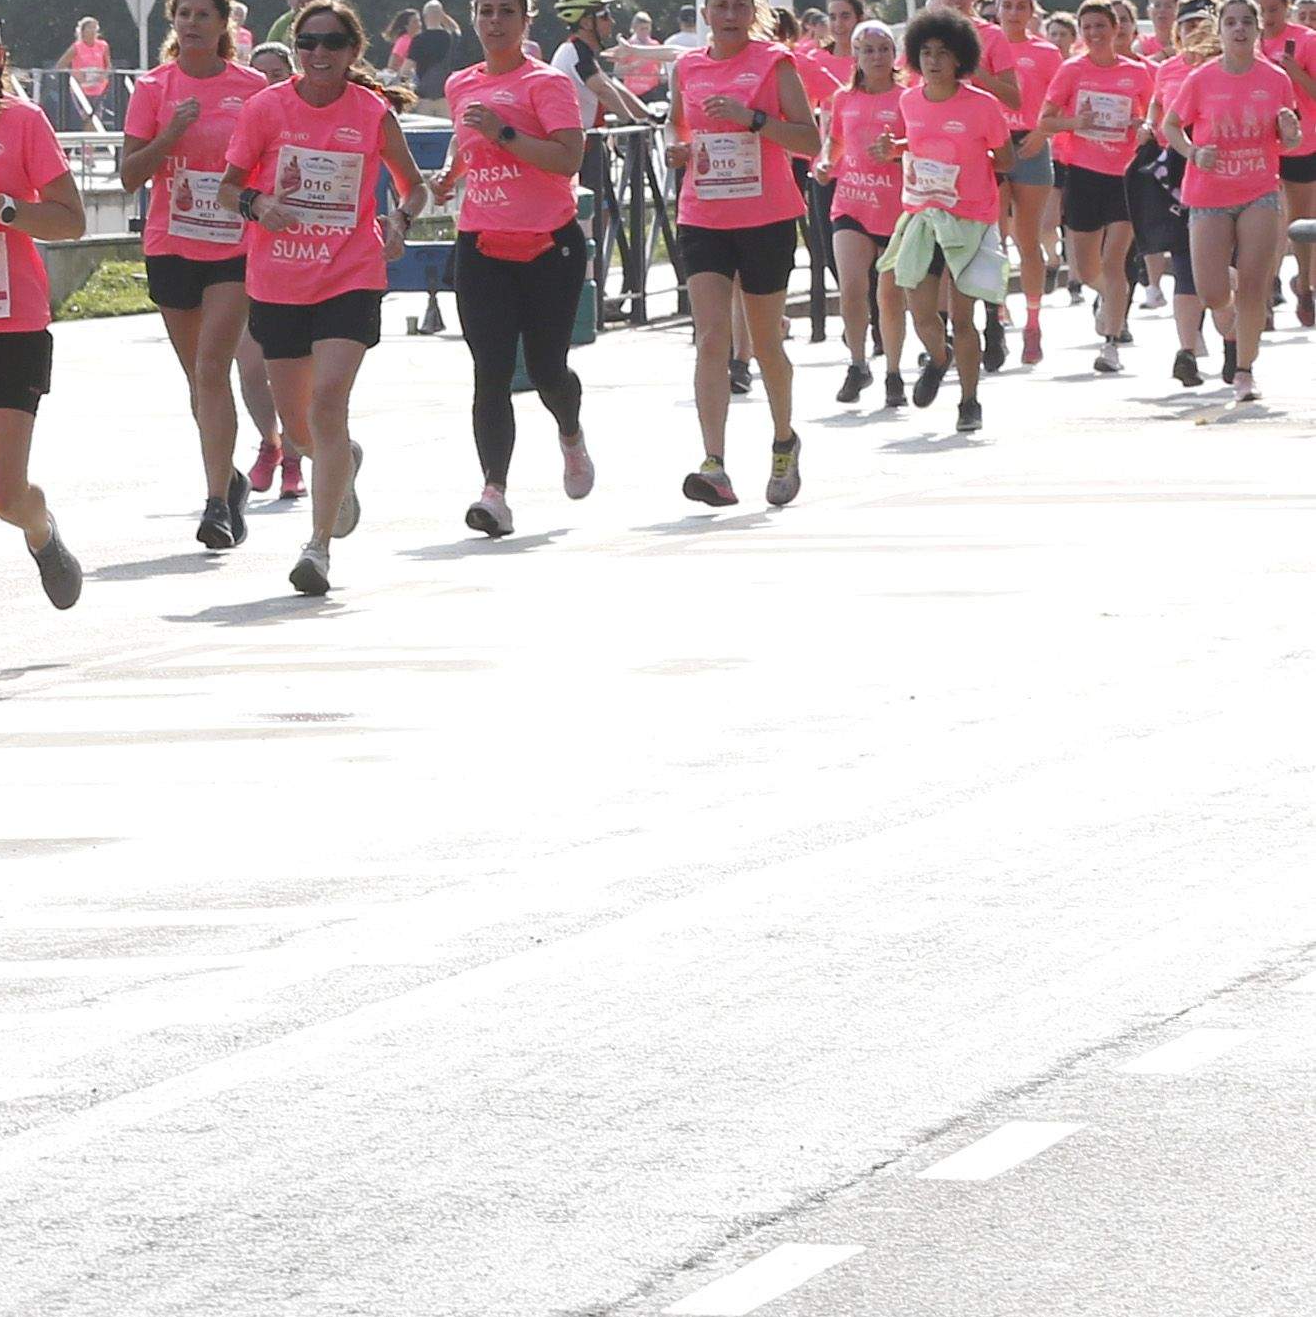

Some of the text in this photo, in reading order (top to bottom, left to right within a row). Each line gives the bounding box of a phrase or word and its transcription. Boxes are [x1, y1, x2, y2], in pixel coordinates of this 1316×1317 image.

[712, 159, 736, 169] 016
[1216, 157, 1266, 175] SUMA
[303, 178, 332, 192] 016
[843, 171, 893, 188] DORSAL
[838, 185, 879, 203] SUMA
[272, 239, 330, 260] SUMA
